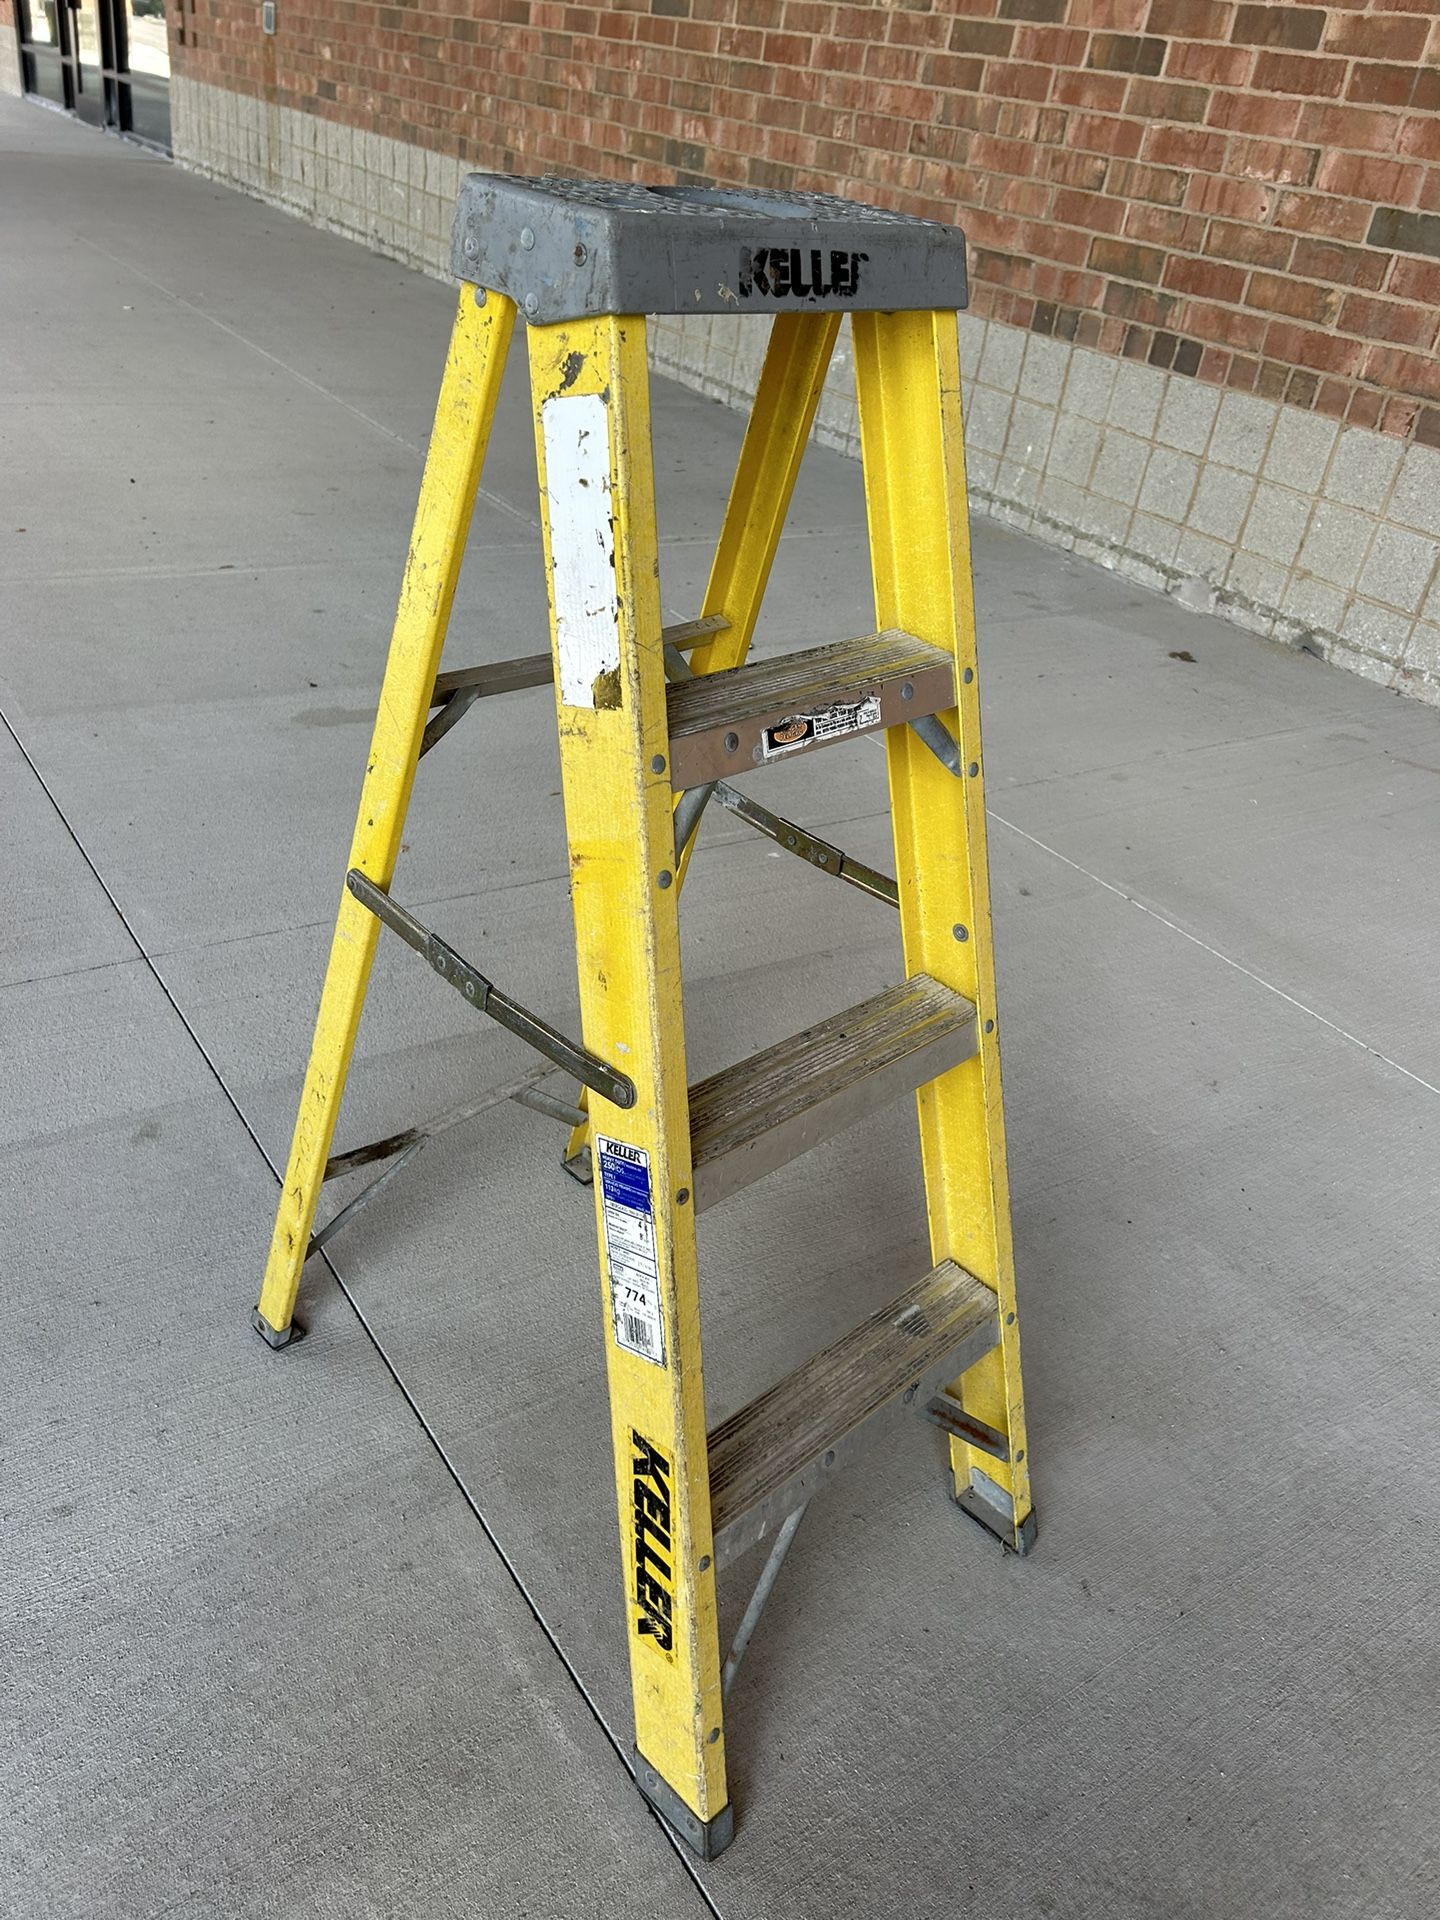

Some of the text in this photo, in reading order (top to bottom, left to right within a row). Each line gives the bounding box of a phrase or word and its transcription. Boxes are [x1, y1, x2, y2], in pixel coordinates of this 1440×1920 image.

[606, 1142, 641, 1164] KELLER
[625, 1286, 646, 1306] 774
[632, 1428, 672, 1650] KELLER
